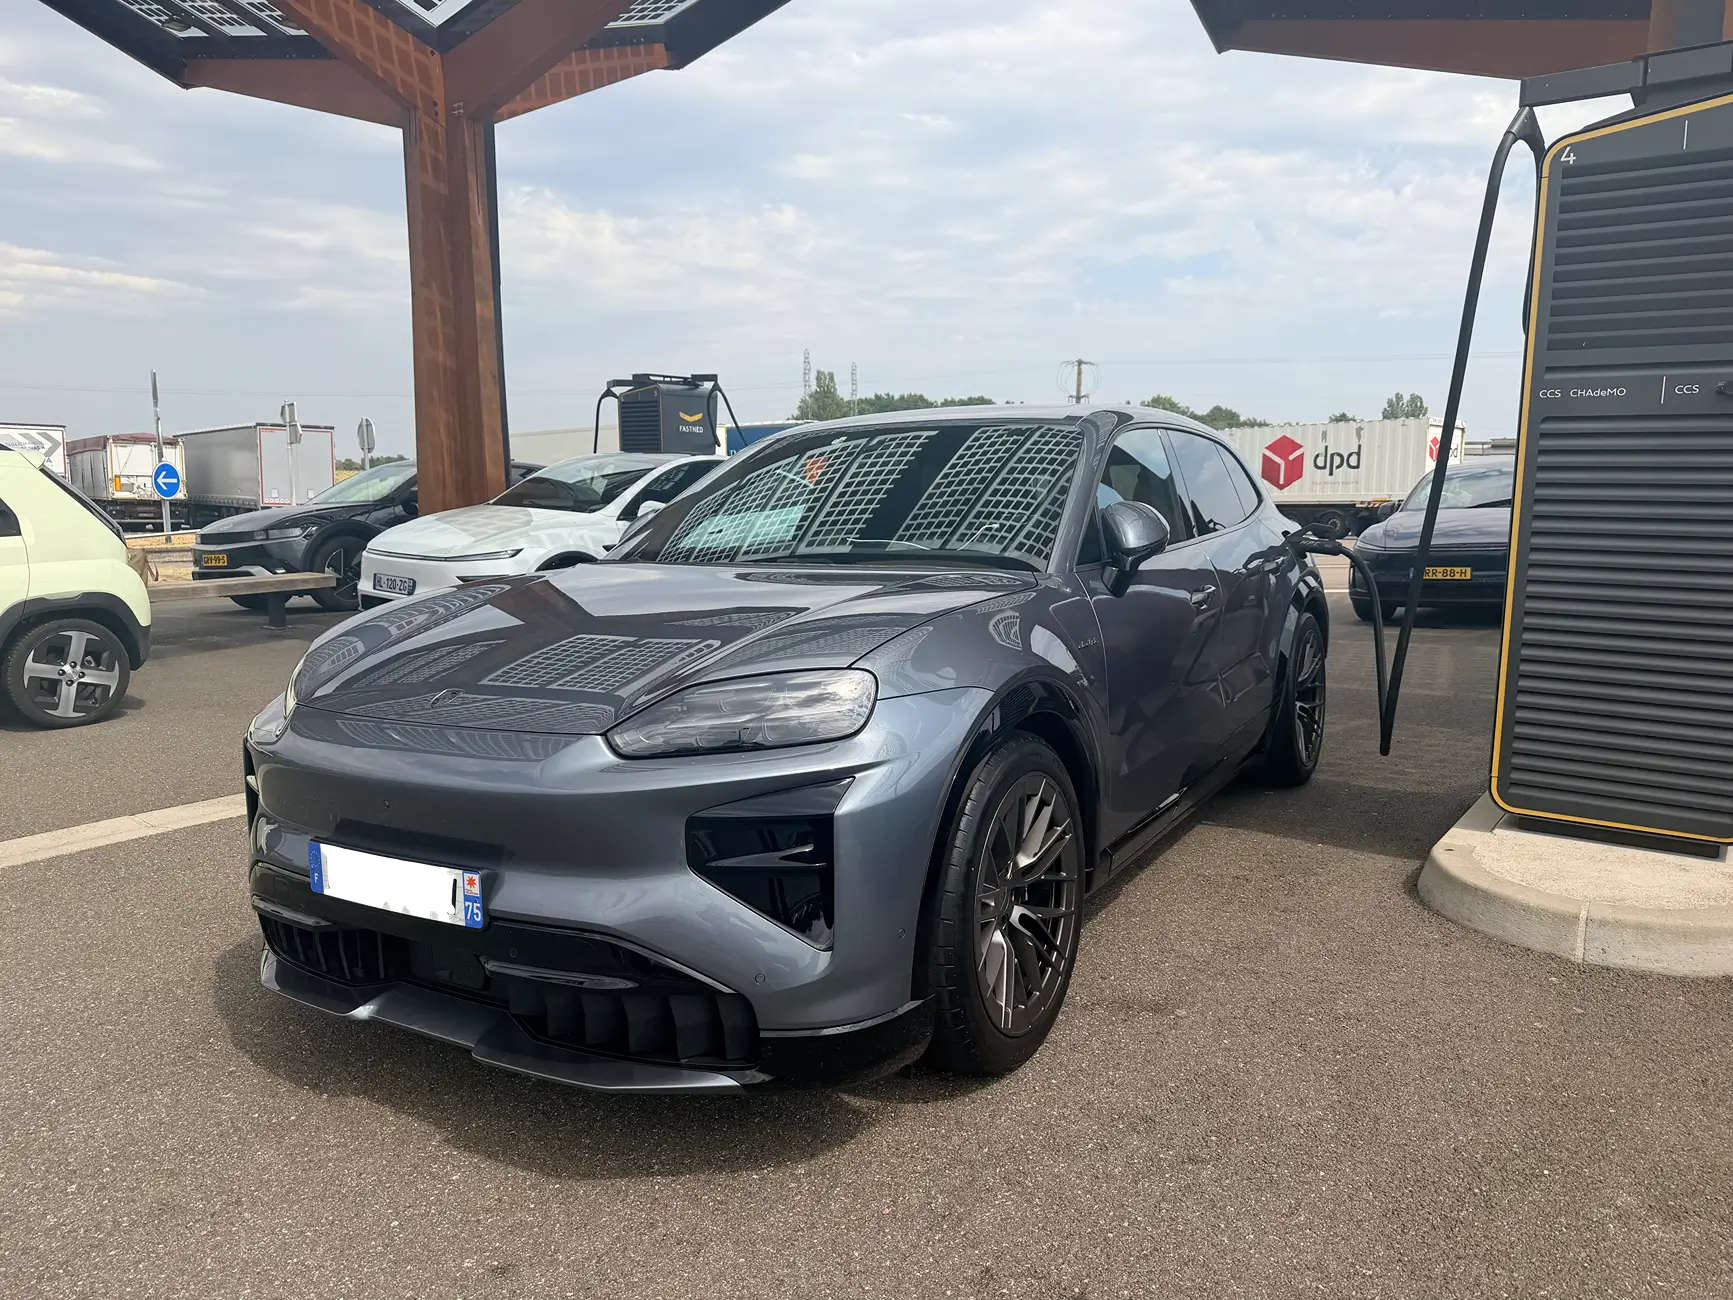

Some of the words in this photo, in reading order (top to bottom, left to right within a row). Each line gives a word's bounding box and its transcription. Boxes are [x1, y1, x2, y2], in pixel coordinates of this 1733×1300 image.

[1561, 146, 1576, 164] 4
[1539, 389, 1561, 398] CCS
[1570, 387, 1627, 397] CHAdeMO
[1675, 384, 1700, 394] CCS
[679, 425, 704, 433] FASTNED
[1313, 444, 1362, 476] dpd
[314, 873, 319, 883] F
[464, 901, 481, 921] 75
